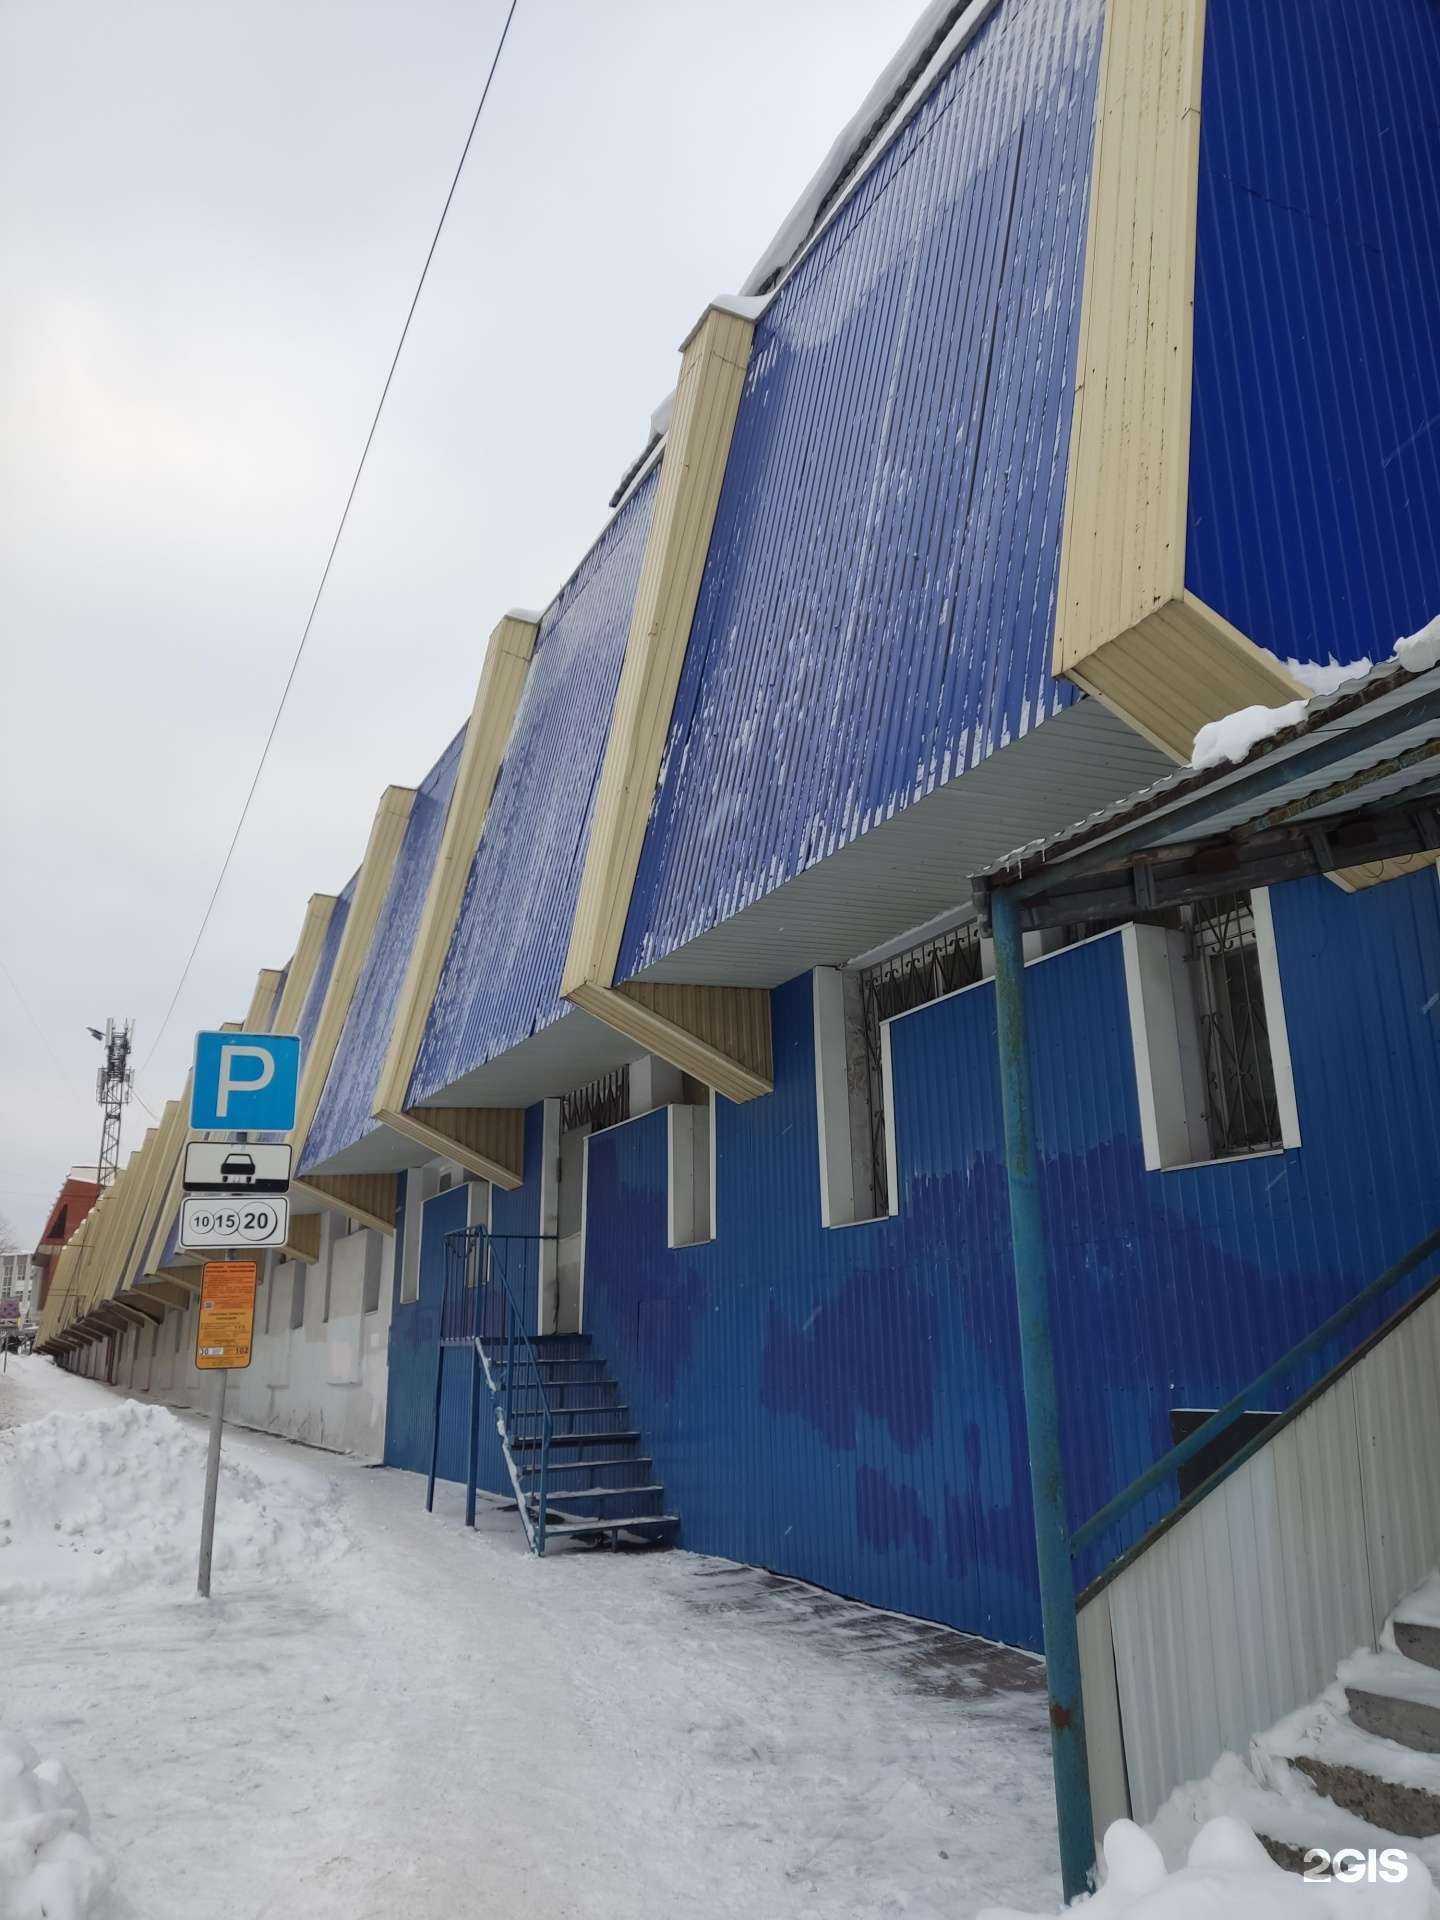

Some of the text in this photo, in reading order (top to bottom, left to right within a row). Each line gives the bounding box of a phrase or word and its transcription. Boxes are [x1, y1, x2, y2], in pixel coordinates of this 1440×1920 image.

[216, 1045, 275, 1117] P
[194, 1213, 268, 1229] 10 15 20
